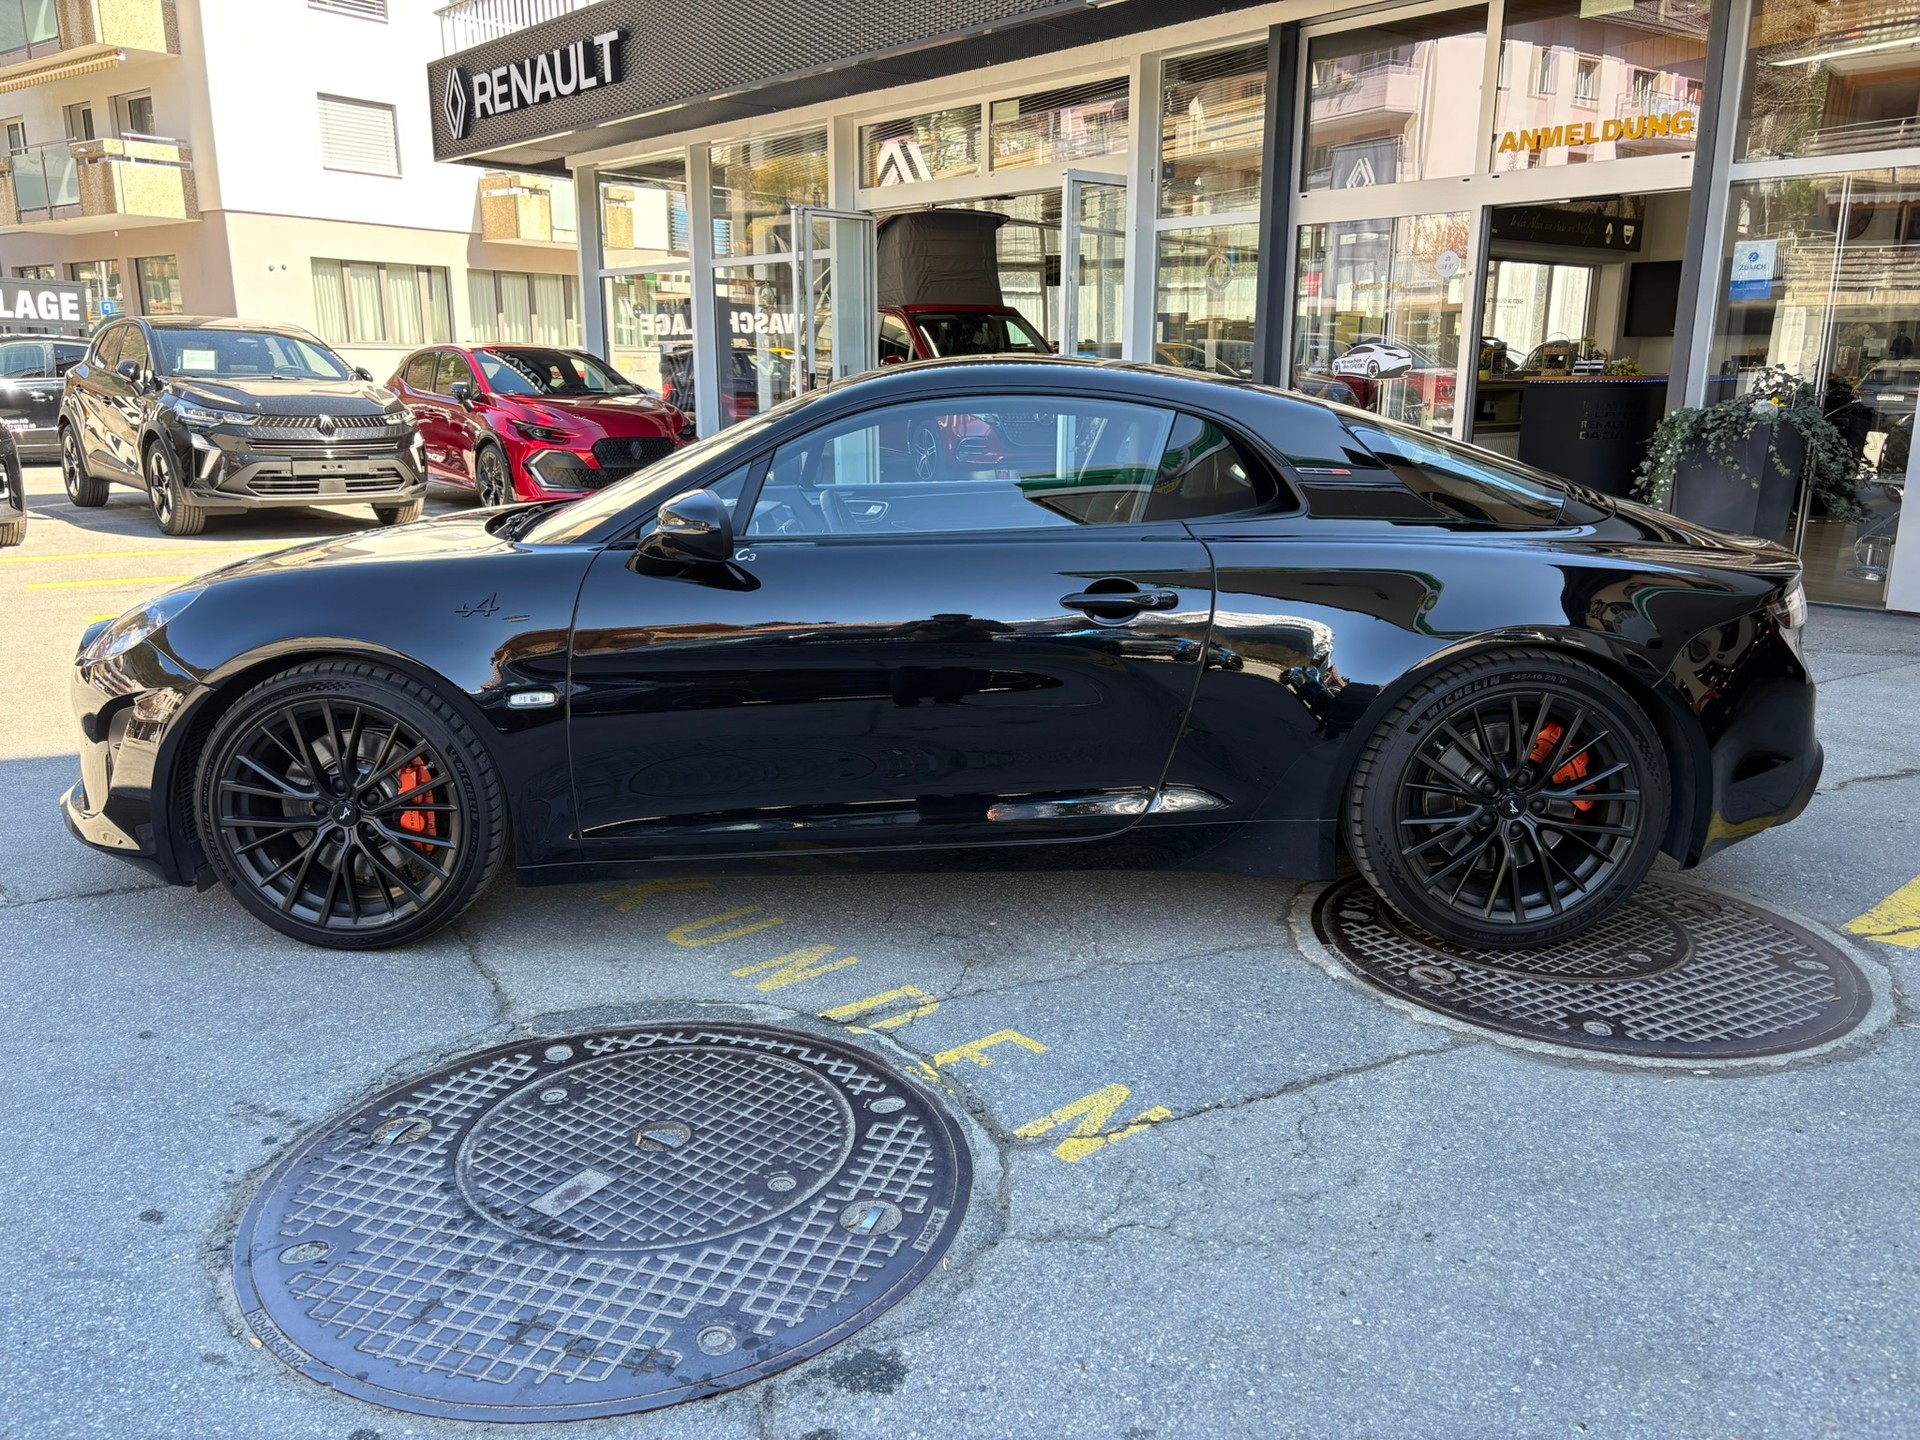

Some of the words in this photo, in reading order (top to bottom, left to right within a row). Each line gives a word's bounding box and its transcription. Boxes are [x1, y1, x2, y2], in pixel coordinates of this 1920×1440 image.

[472, 30, 619, 118] RENAULT
[1498, 111, 1694, 154] ANMELDUNG
[0, 289, 80, 321] LAGE
[1427, 675, 1501, 718] MICHELIN
[1510, 673, 1542, 682] 245/40
[455, 761, 478, 822] MICHELIN
